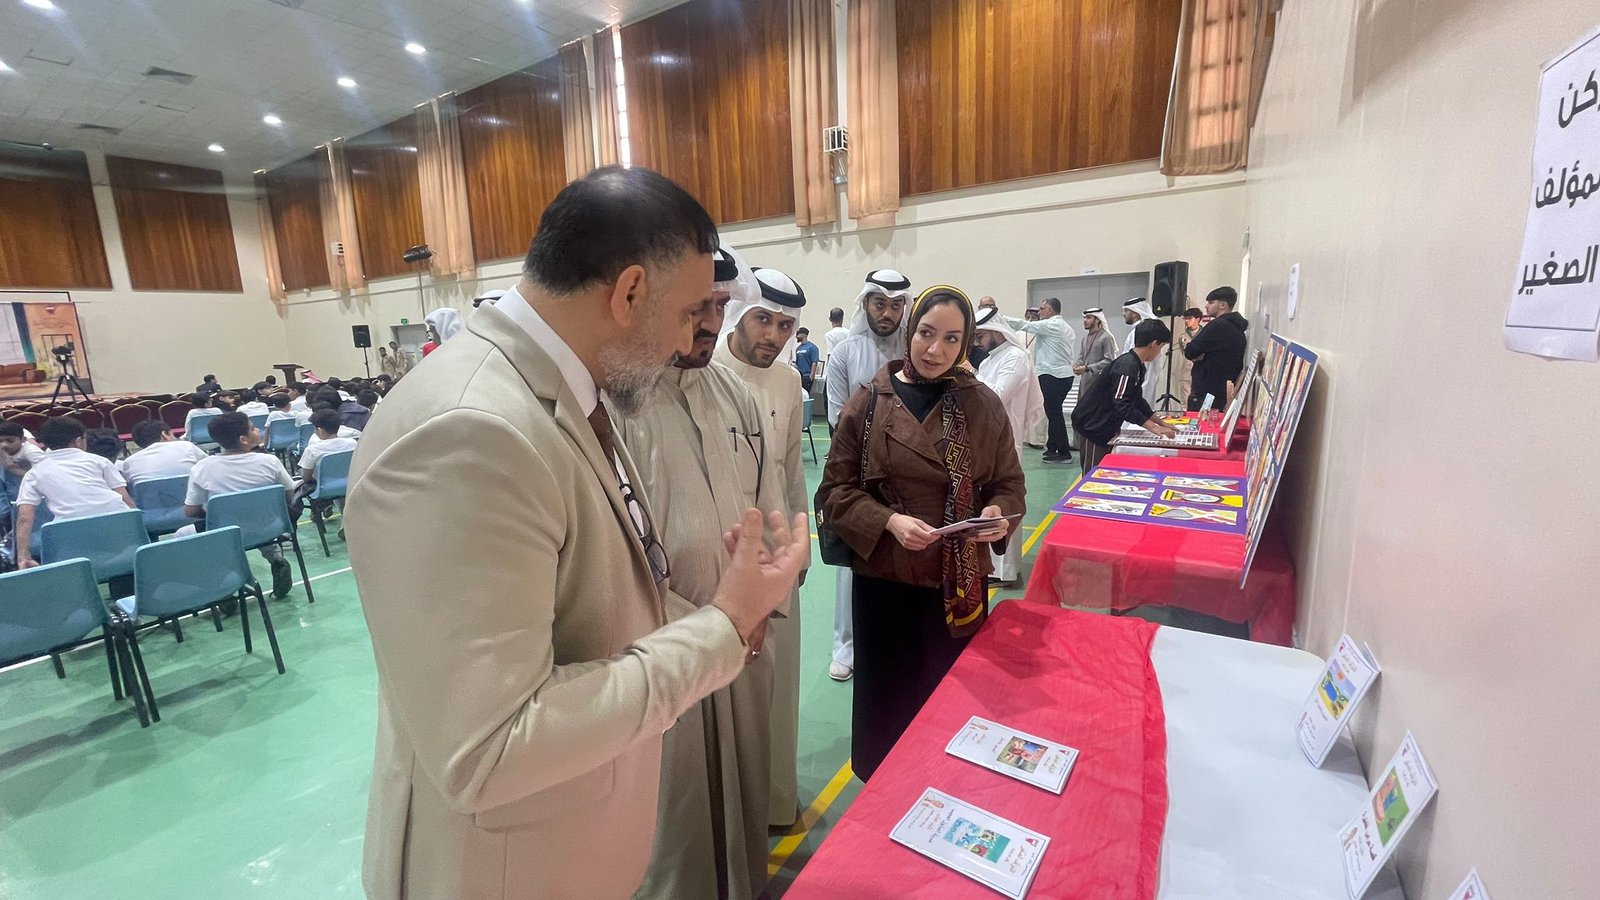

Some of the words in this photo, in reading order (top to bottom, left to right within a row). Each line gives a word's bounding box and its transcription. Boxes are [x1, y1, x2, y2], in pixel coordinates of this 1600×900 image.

[1558, 68, 1600, 129] كن
[1535, 160, 1600, 209] مؤلف
[1518, 244, 1599, 295] الصغير
